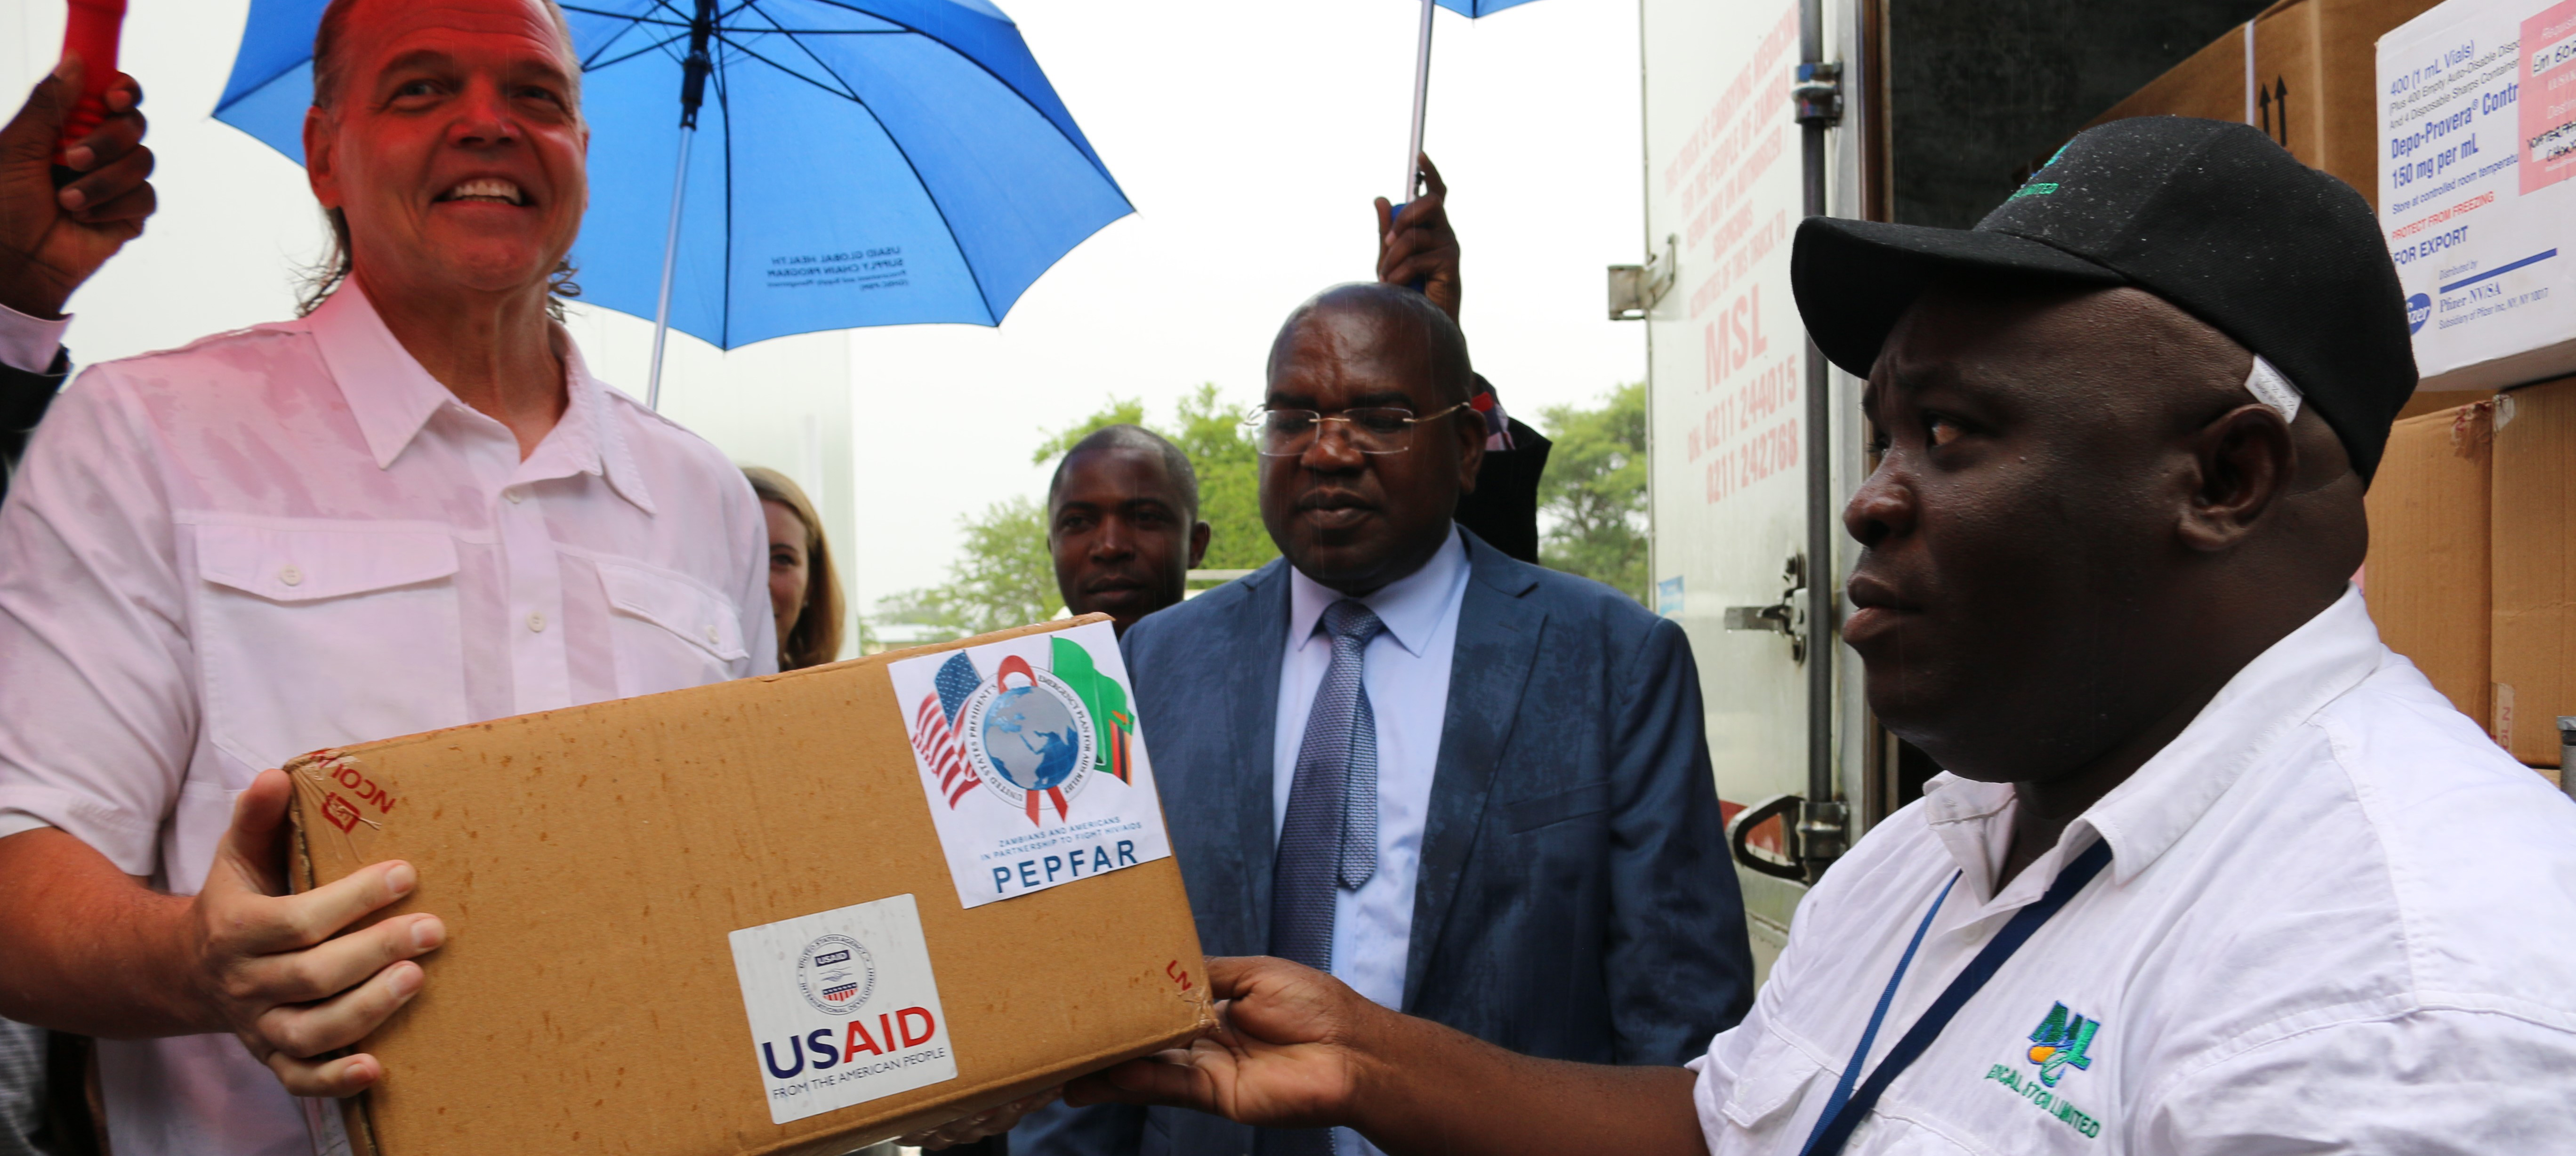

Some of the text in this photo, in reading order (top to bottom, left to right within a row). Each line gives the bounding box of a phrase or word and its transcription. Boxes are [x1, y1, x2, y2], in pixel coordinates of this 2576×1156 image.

[2391, 75, 2409, 96] 400
[2444, 40, 2474, 68] Vials)
[2392, 132, 2479, 189] 150 mg per mL
[2419, 225, 2469, 258] EXPORT
[1705, 282, 1767, 393] MSL
[1706, 393, 1735, 451] 0211
[1739, 354, 1796, 431] 244015
[1707, 417, 1799, 505] 0211 242768
[993, 838, 1057, 858] PARTNERSHIP
[1060, 835, 1072, 844] TO
[1076, 829, 1102, 840] FIGHT
[998, 816, 1121, 847] ZAMBIANS AND AMERICANS
[992, 839, 1138, 894] PEPFAR
[816, 952, 849, 965] USAID
[762, 1006, 936, 1079] USAID
[772, 1048, 946, 1100] FROM THE AMERICAN PEOPLE
